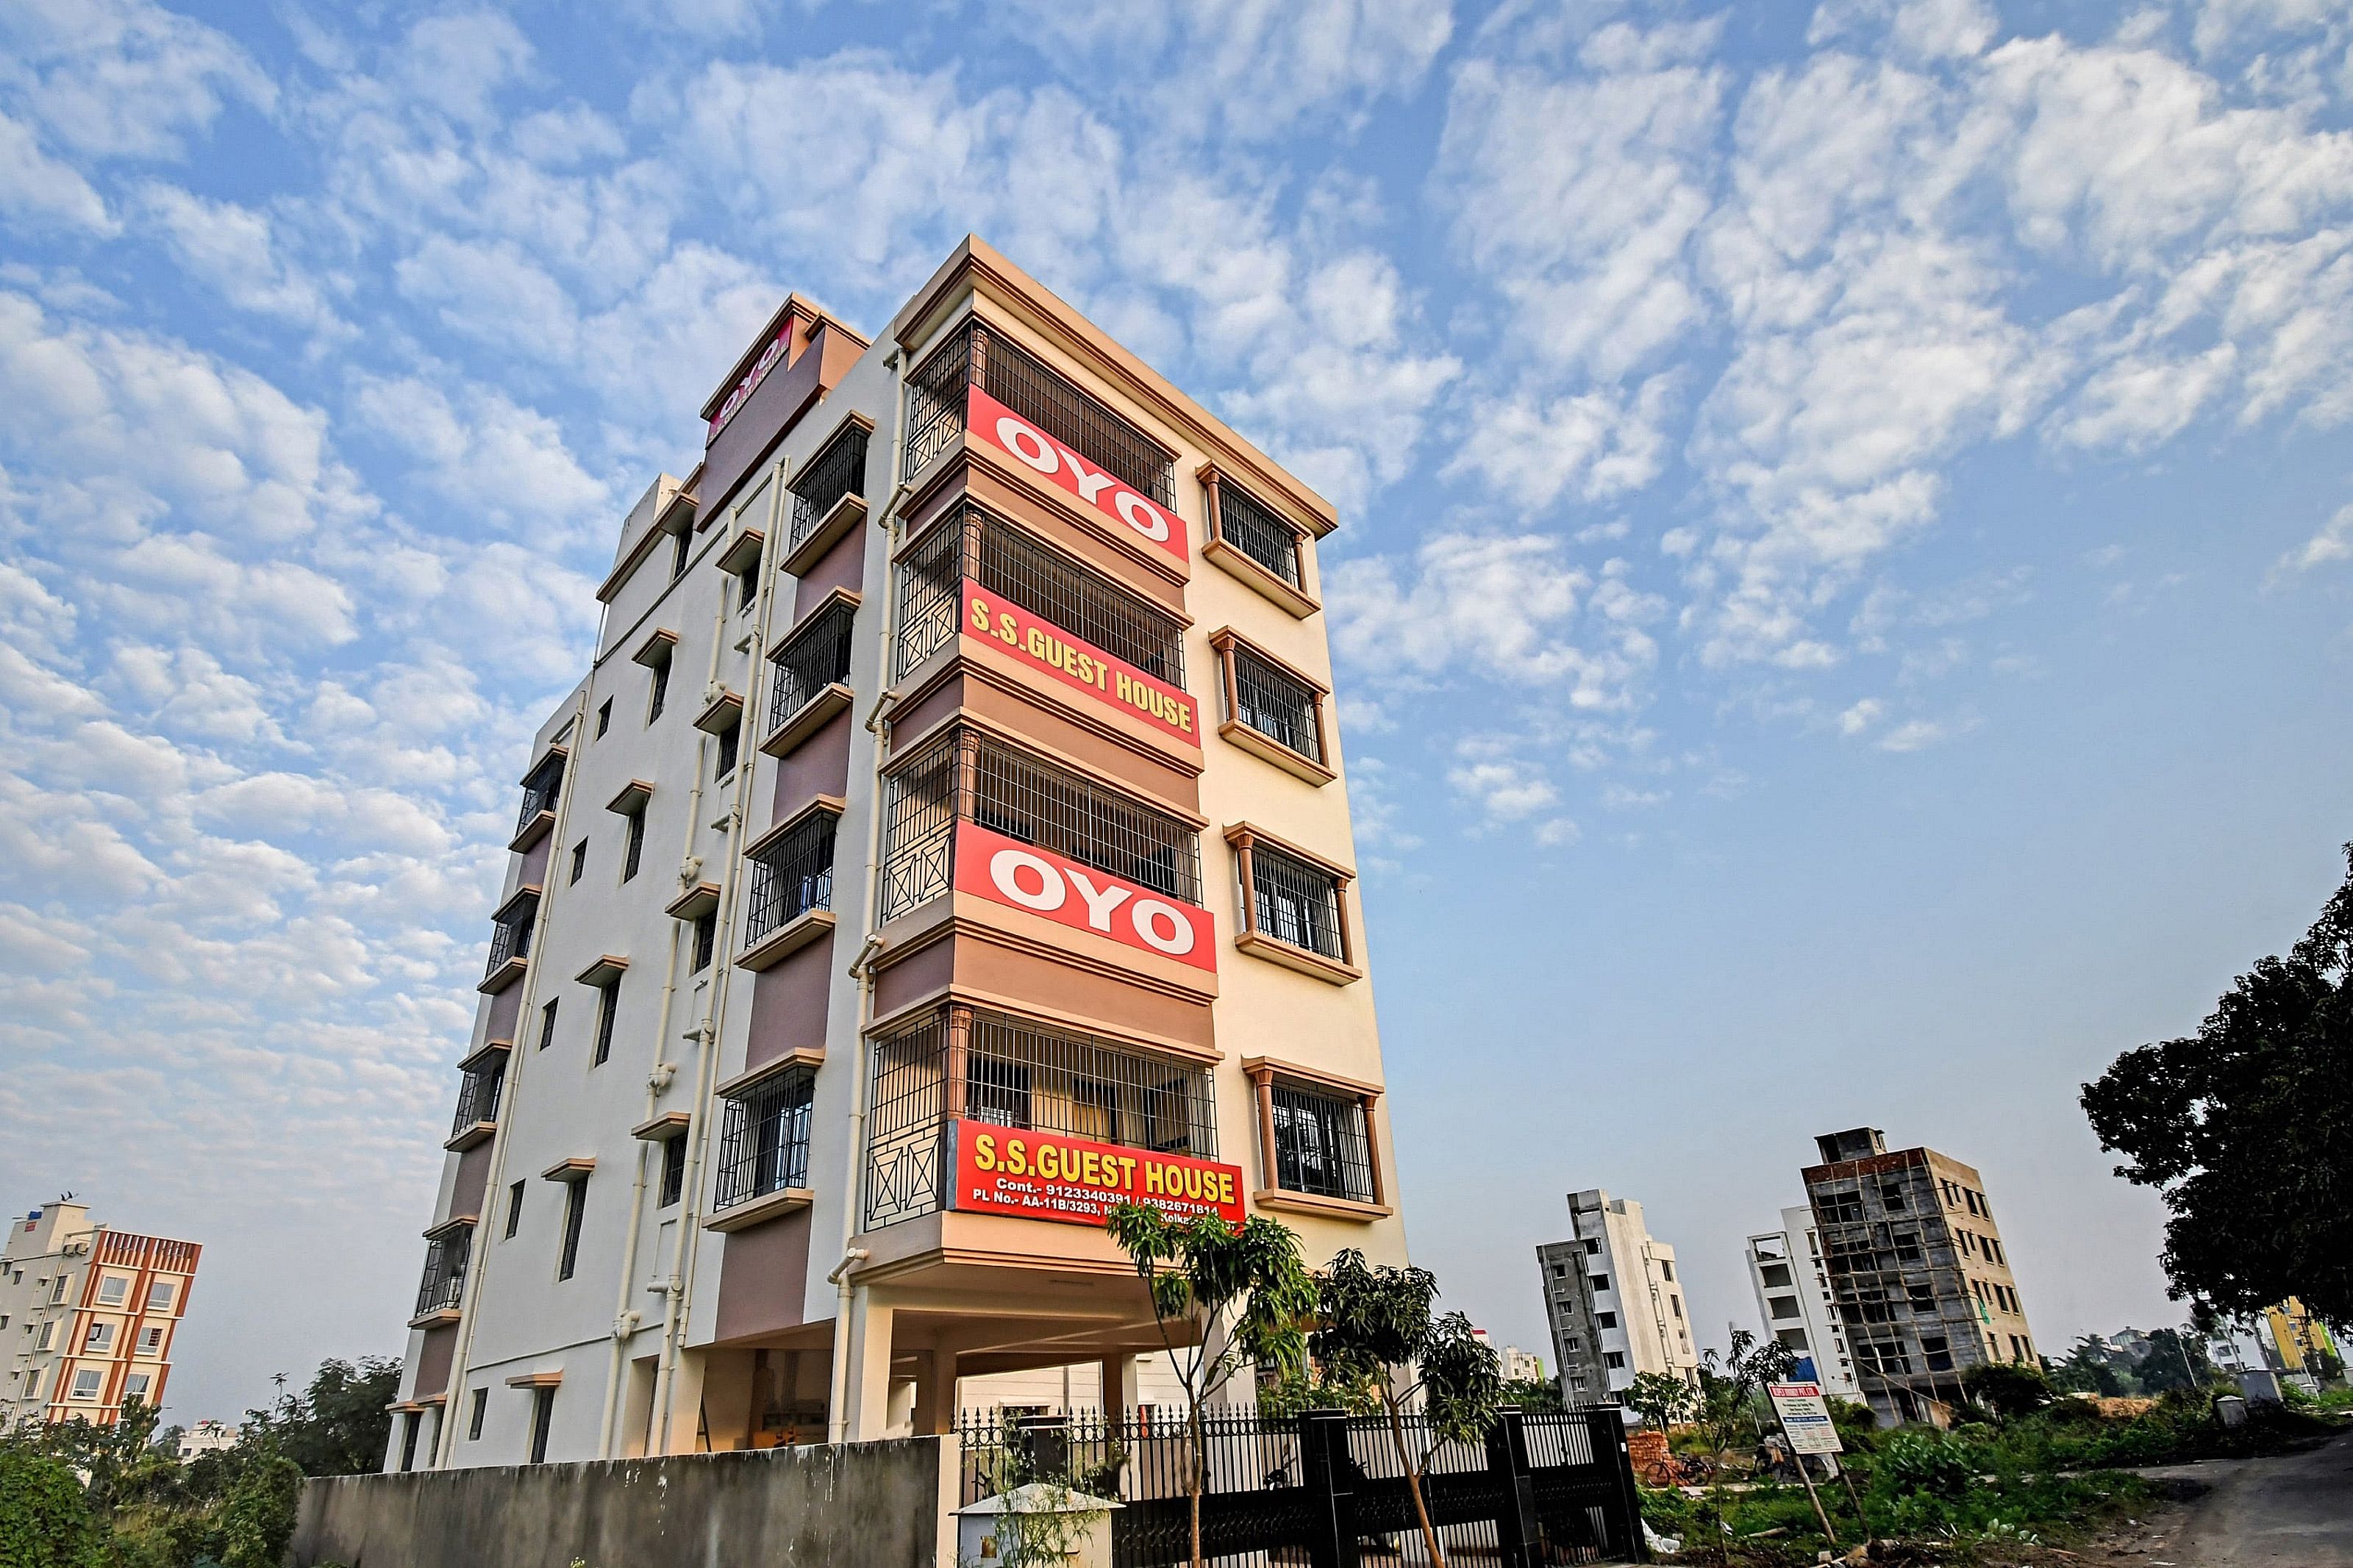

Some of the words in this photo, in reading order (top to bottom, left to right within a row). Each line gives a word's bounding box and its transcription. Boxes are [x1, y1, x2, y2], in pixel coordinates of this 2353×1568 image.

[719, 338, 779, 419] OYO
[996, 417, 1170, 543] OYO
[971, 597, 1108, 692] S.S.GUEST
[1115, 669, 1193, 734] HOUSE
[989, 849, 1195, 955] OYO
[973, 1189, 990, 1202] PL
[993, 1191, 1019, 1205] No.-
[1021, 1195, 1101, 1217] AA-11B/3293,
[974, 1134, 1136, 1190] S.S.GUEST
[1145, 1160, 1235, 1204] HOUSE
[996, 1178, 1043, 1194] Cont.-
[1046, 1184, 1131, 1206] 9123340391
[1143, 1197, 1219, 1217] 9382671814
